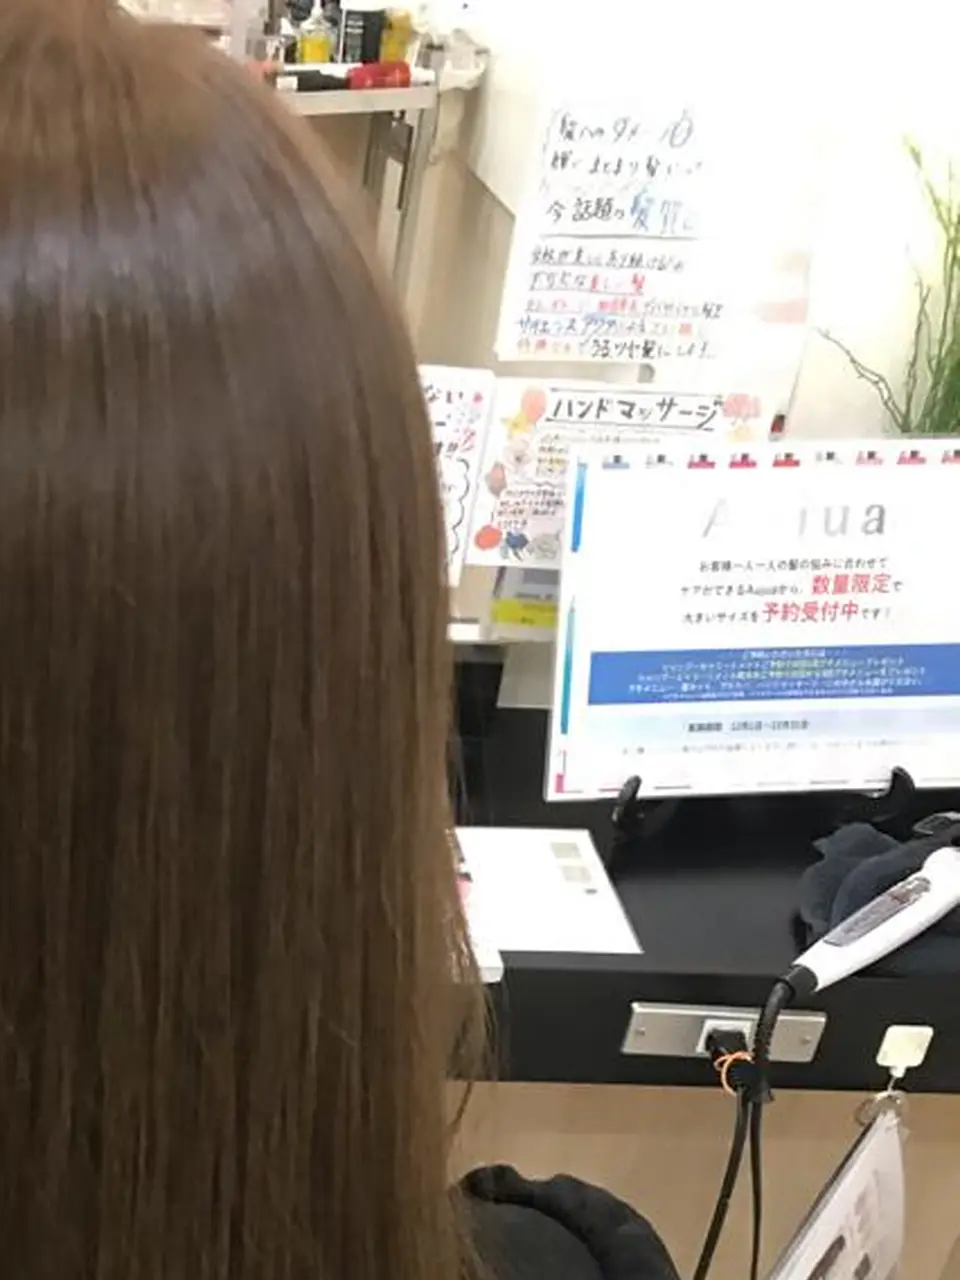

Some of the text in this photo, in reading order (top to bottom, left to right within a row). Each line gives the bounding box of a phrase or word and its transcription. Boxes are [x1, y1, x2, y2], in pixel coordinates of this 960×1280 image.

[552, 394, 724, 430] ハンドマッサージ
